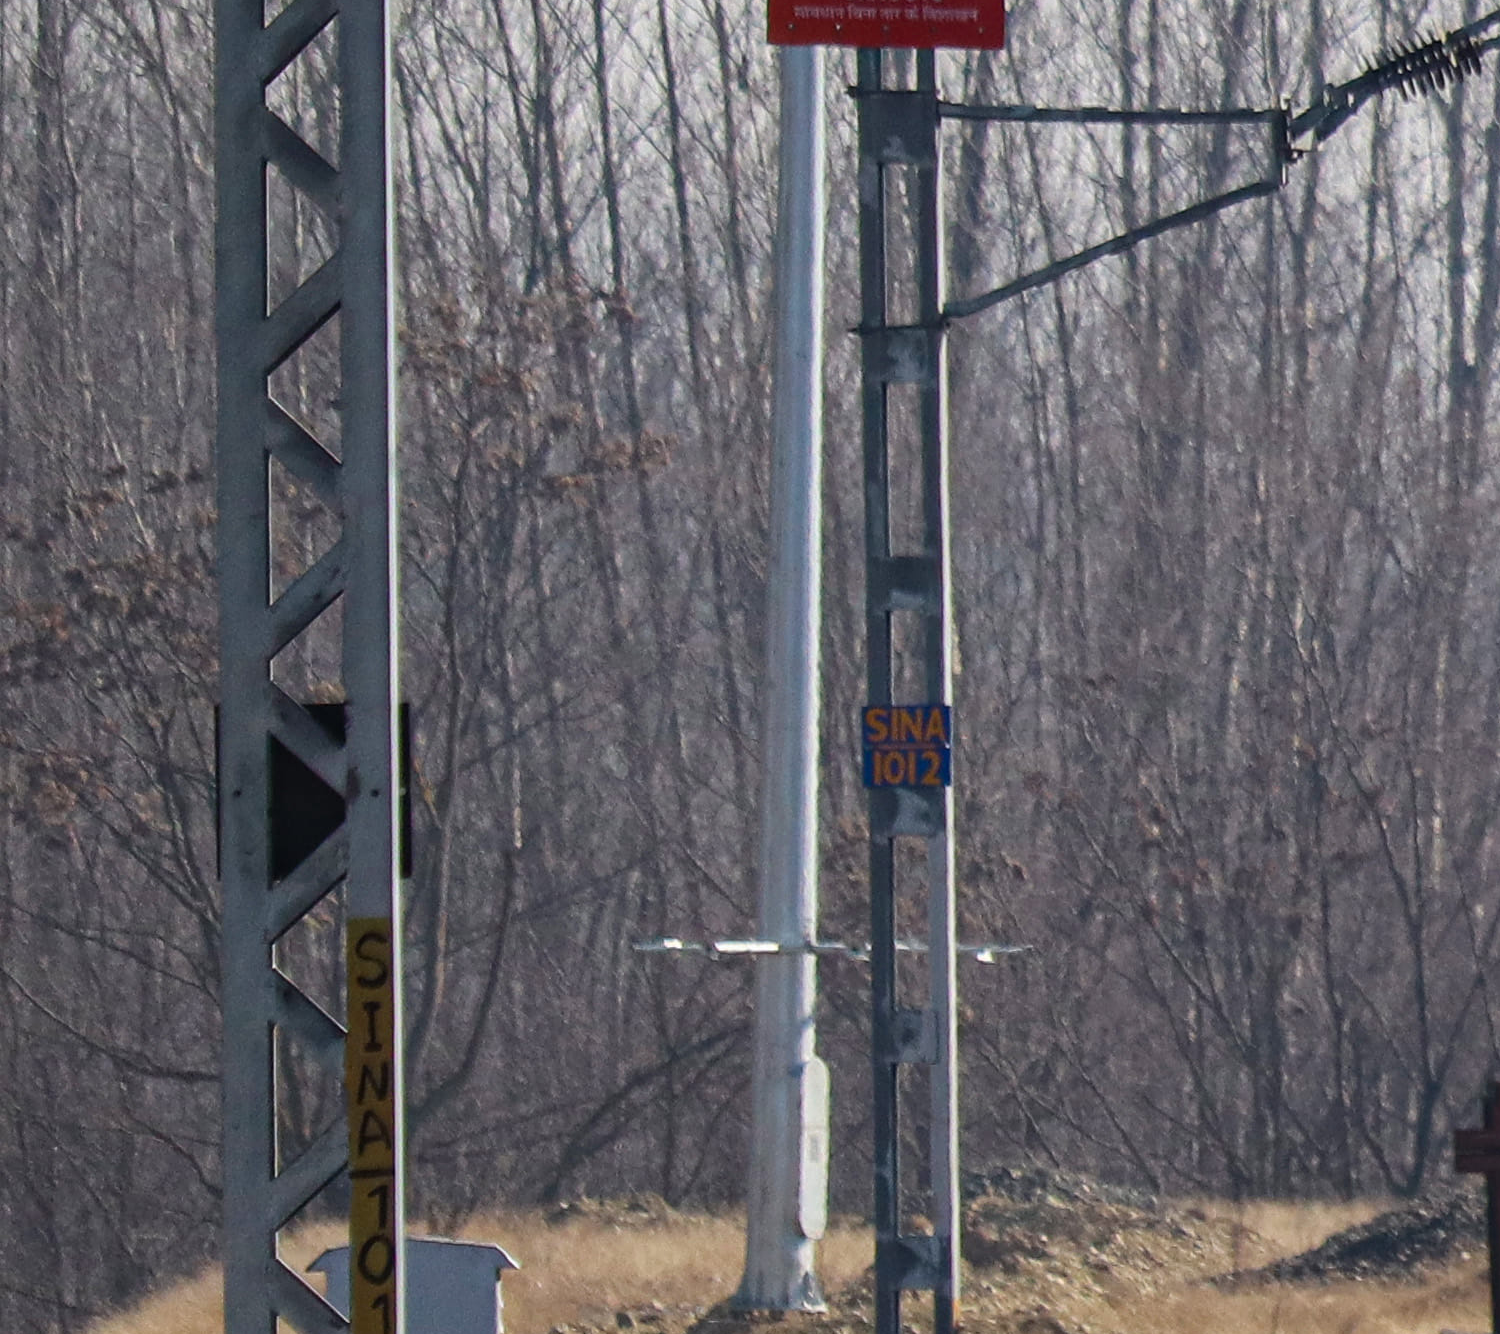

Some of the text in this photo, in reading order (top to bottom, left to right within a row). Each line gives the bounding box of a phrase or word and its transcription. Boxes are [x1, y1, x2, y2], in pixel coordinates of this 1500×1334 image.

[865, 707, 947, 742] SINA
[872, 749, 942, 786] 1012
[354, 931, 393, 1156] SINA
